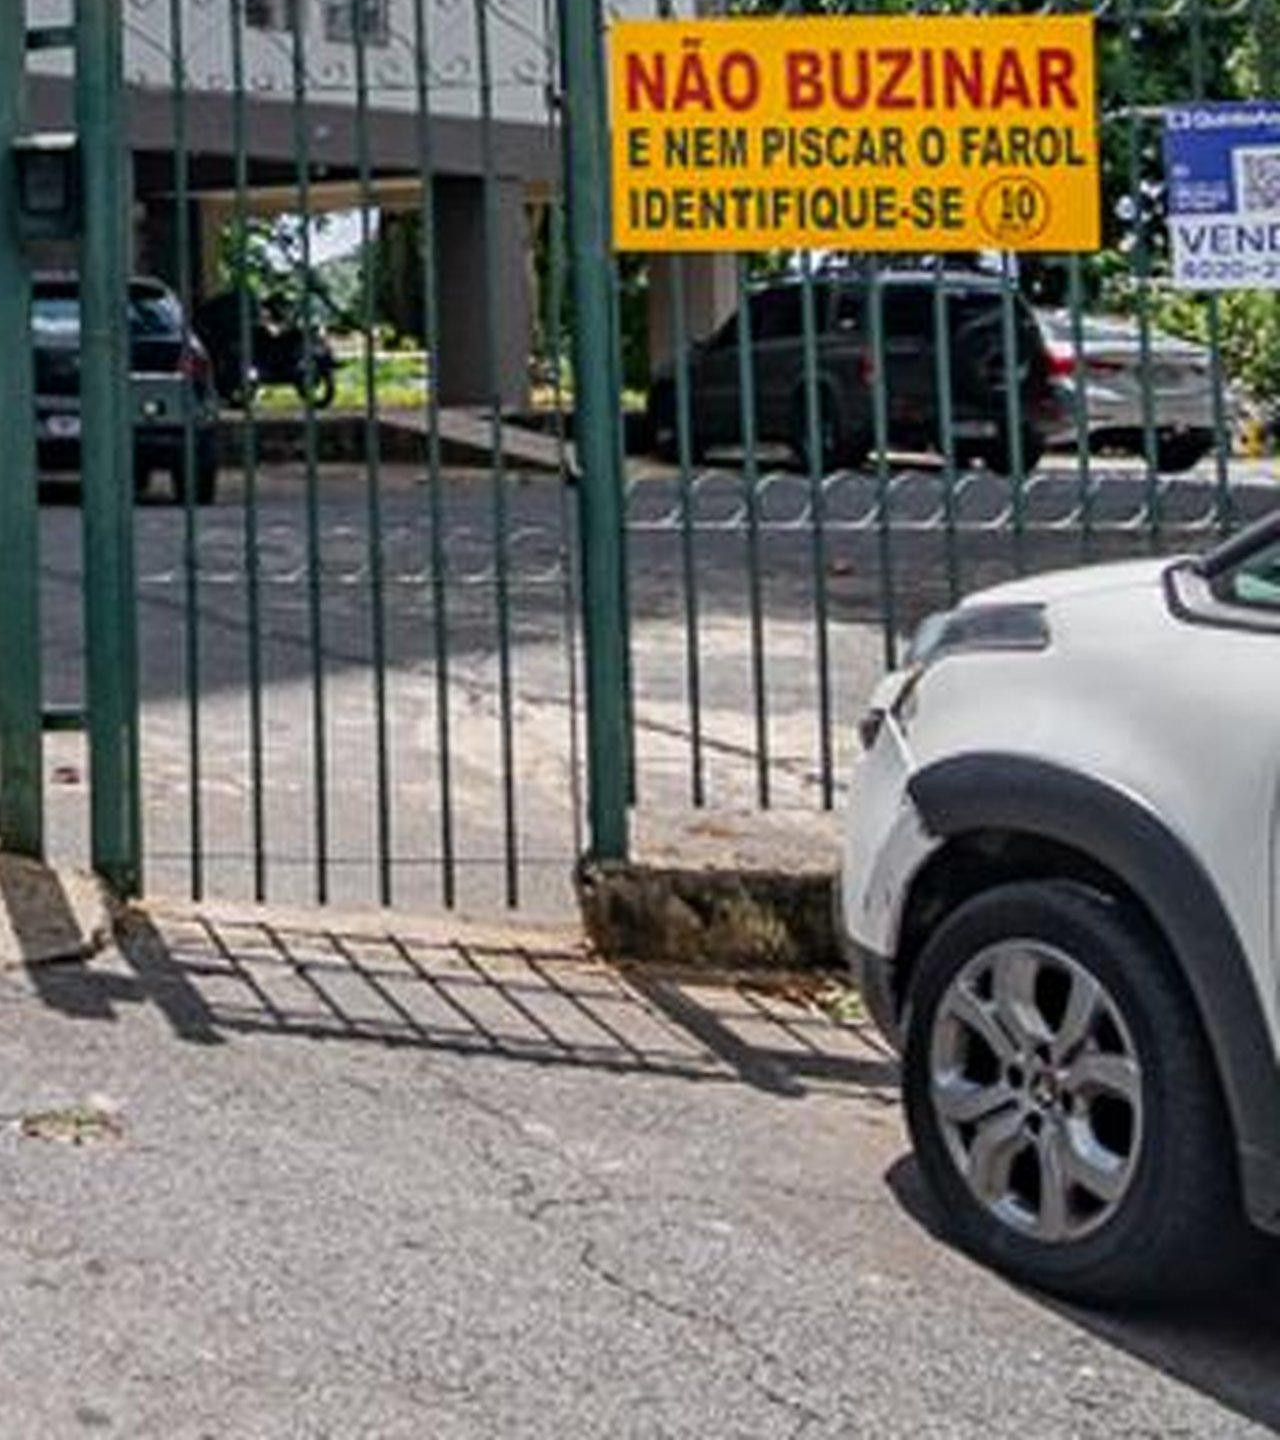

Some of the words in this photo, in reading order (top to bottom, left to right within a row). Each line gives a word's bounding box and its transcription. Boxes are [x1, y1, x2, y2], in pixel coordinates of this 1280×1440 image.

[626, 37, 760, 112] NÃO
[786, 47, 1078, 112] BUZINAR
[628, 128, 650, 167] E
[665, 128, 747, 167] NEM
[761, 127, 905, 167] PISCAR
[918, 127, 945, 167] O
[960, 126, 1086, 166] FAROL
[628, 186, 964, 229] IDENTIFIQUE-SE
